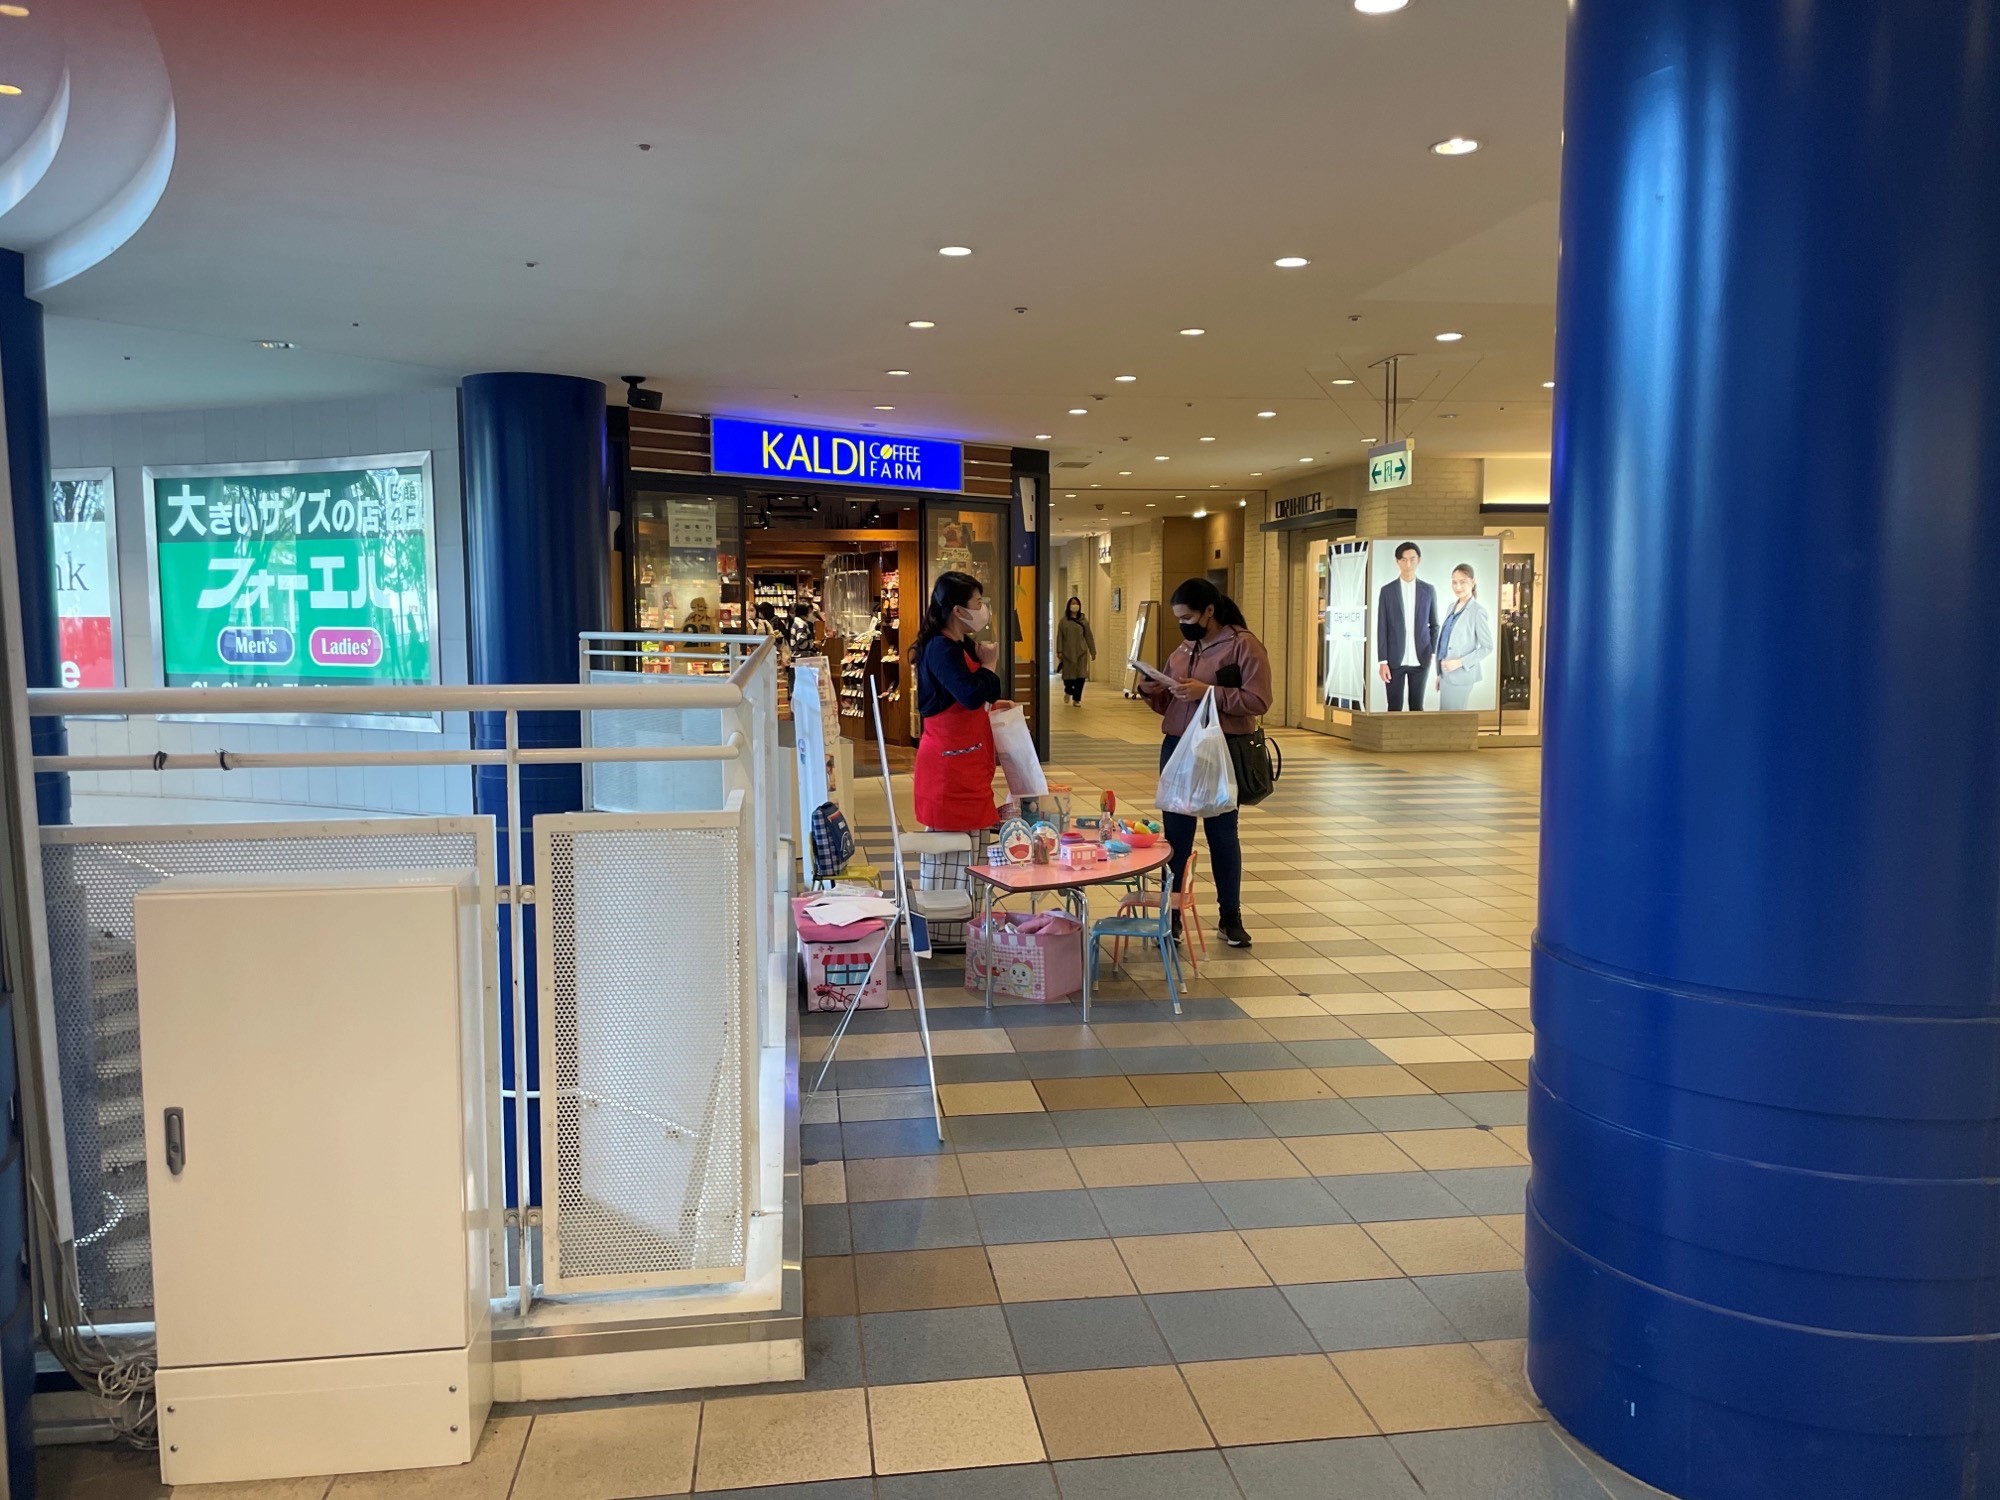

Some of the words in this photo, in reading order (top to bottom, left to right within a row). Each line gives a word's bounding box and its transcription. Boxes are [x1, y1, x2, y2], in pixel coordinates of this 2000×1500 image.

[762, 430, 866, 477] KALDI
[869, 442, 922, 463] COFFEE
[869, 460, 922, 481] FARM
[167, 484, 380, 537] 大きいサイズの店
[1275, 491, 1321, 519] ORIHICA
[196, 555, 394, 609] フォーエル
[235, 636, 278, 654] Men's
[320, 637, 372, 656] Ladies'
